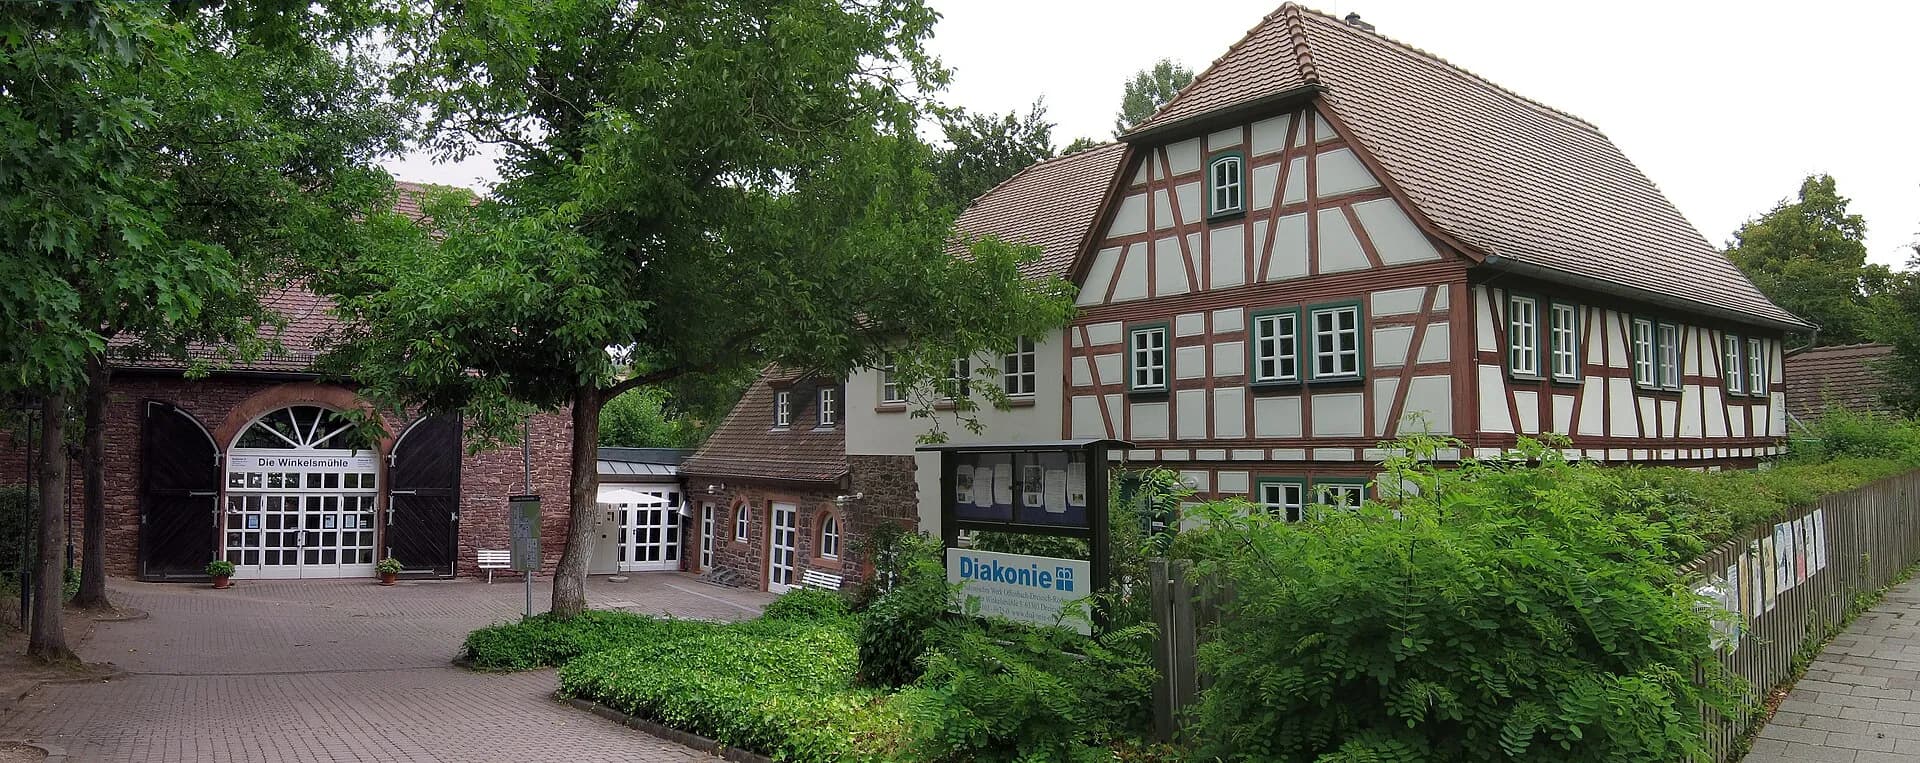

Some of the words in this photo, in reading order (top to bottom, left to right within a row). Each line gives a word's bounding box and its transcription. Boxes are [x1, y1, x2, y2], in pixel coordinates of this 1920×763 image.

[258, 458, 275, 467] Die
[278, 458, 348, 467] Winkelsmühle
[960, 556, 1052, 589] Diakonie
